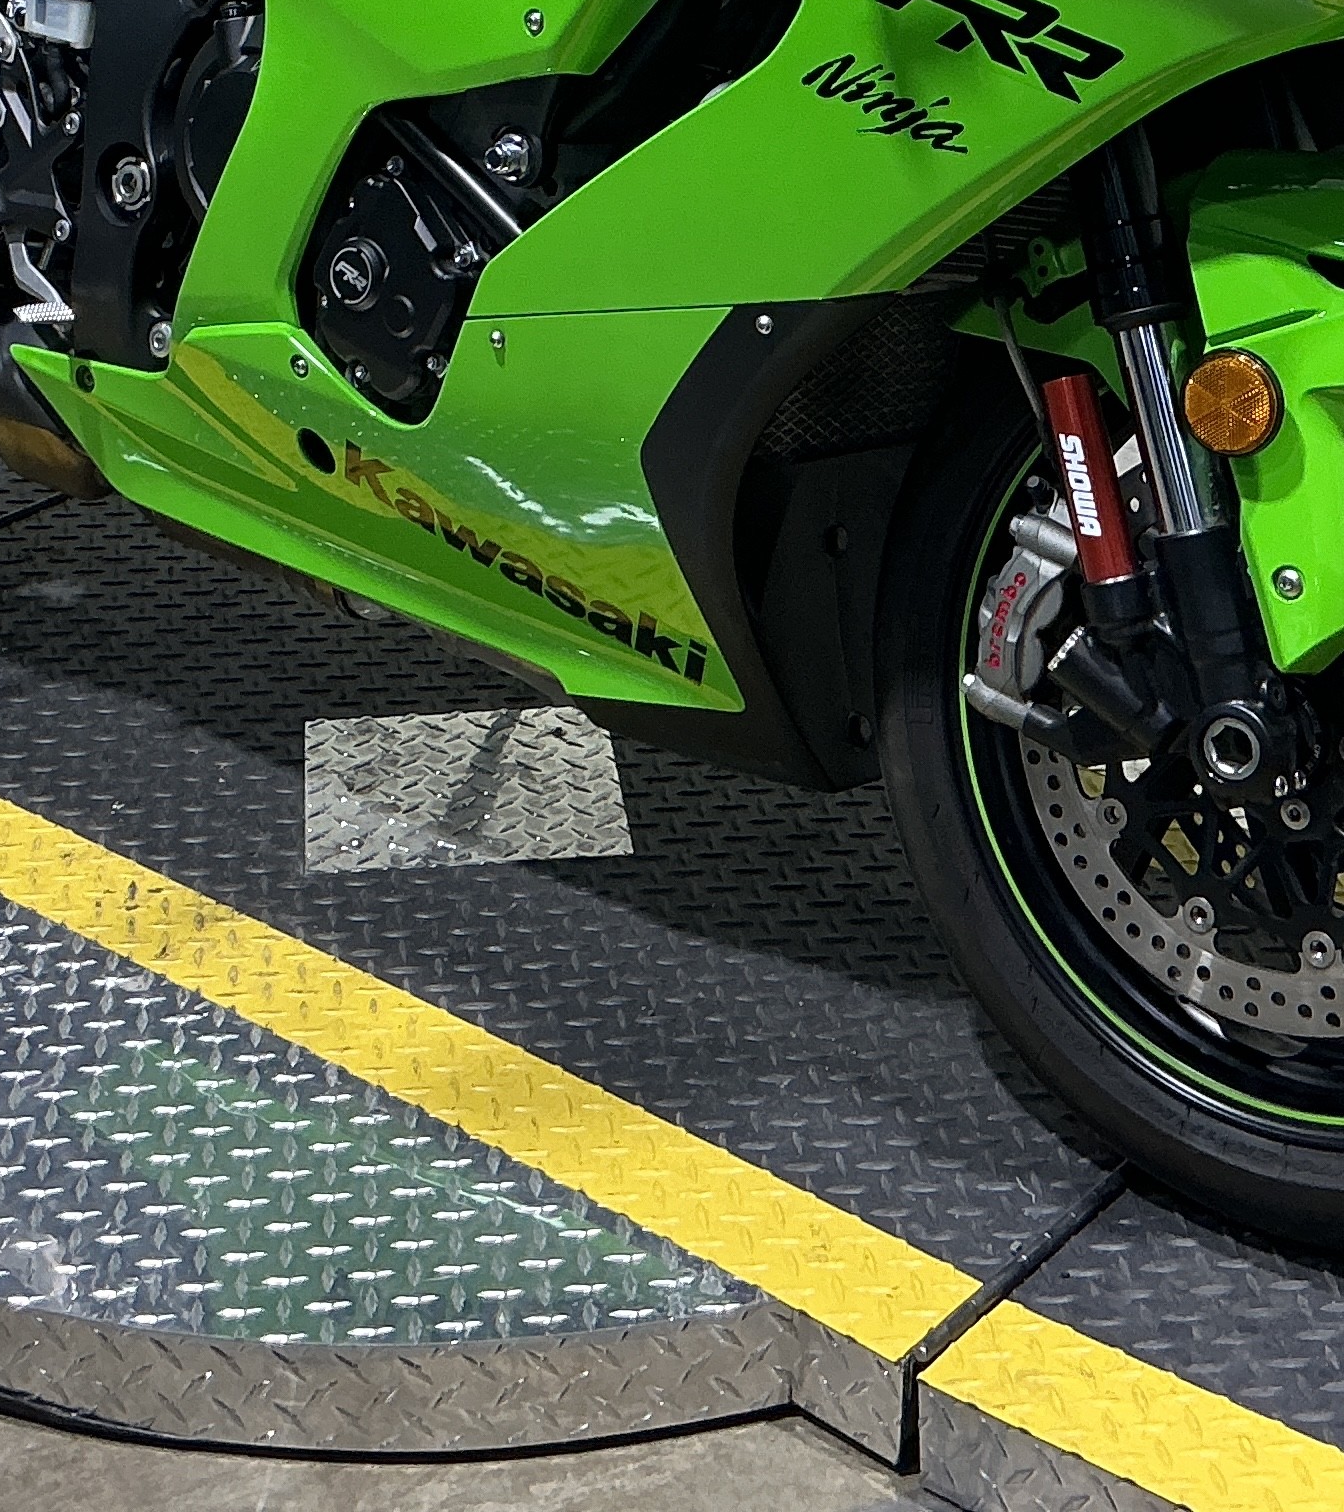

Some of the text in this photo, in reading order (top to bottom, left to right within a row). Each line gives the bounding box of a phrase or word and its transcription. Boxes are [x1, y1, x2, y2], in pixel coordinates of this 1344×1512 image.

[800, 54, 969, 156] Ninja
[1058, 432, 1102, 538] SHOWA
[344, 438, 709, 687] Kawasaki
[983, 571, 1027, 670] brembo
